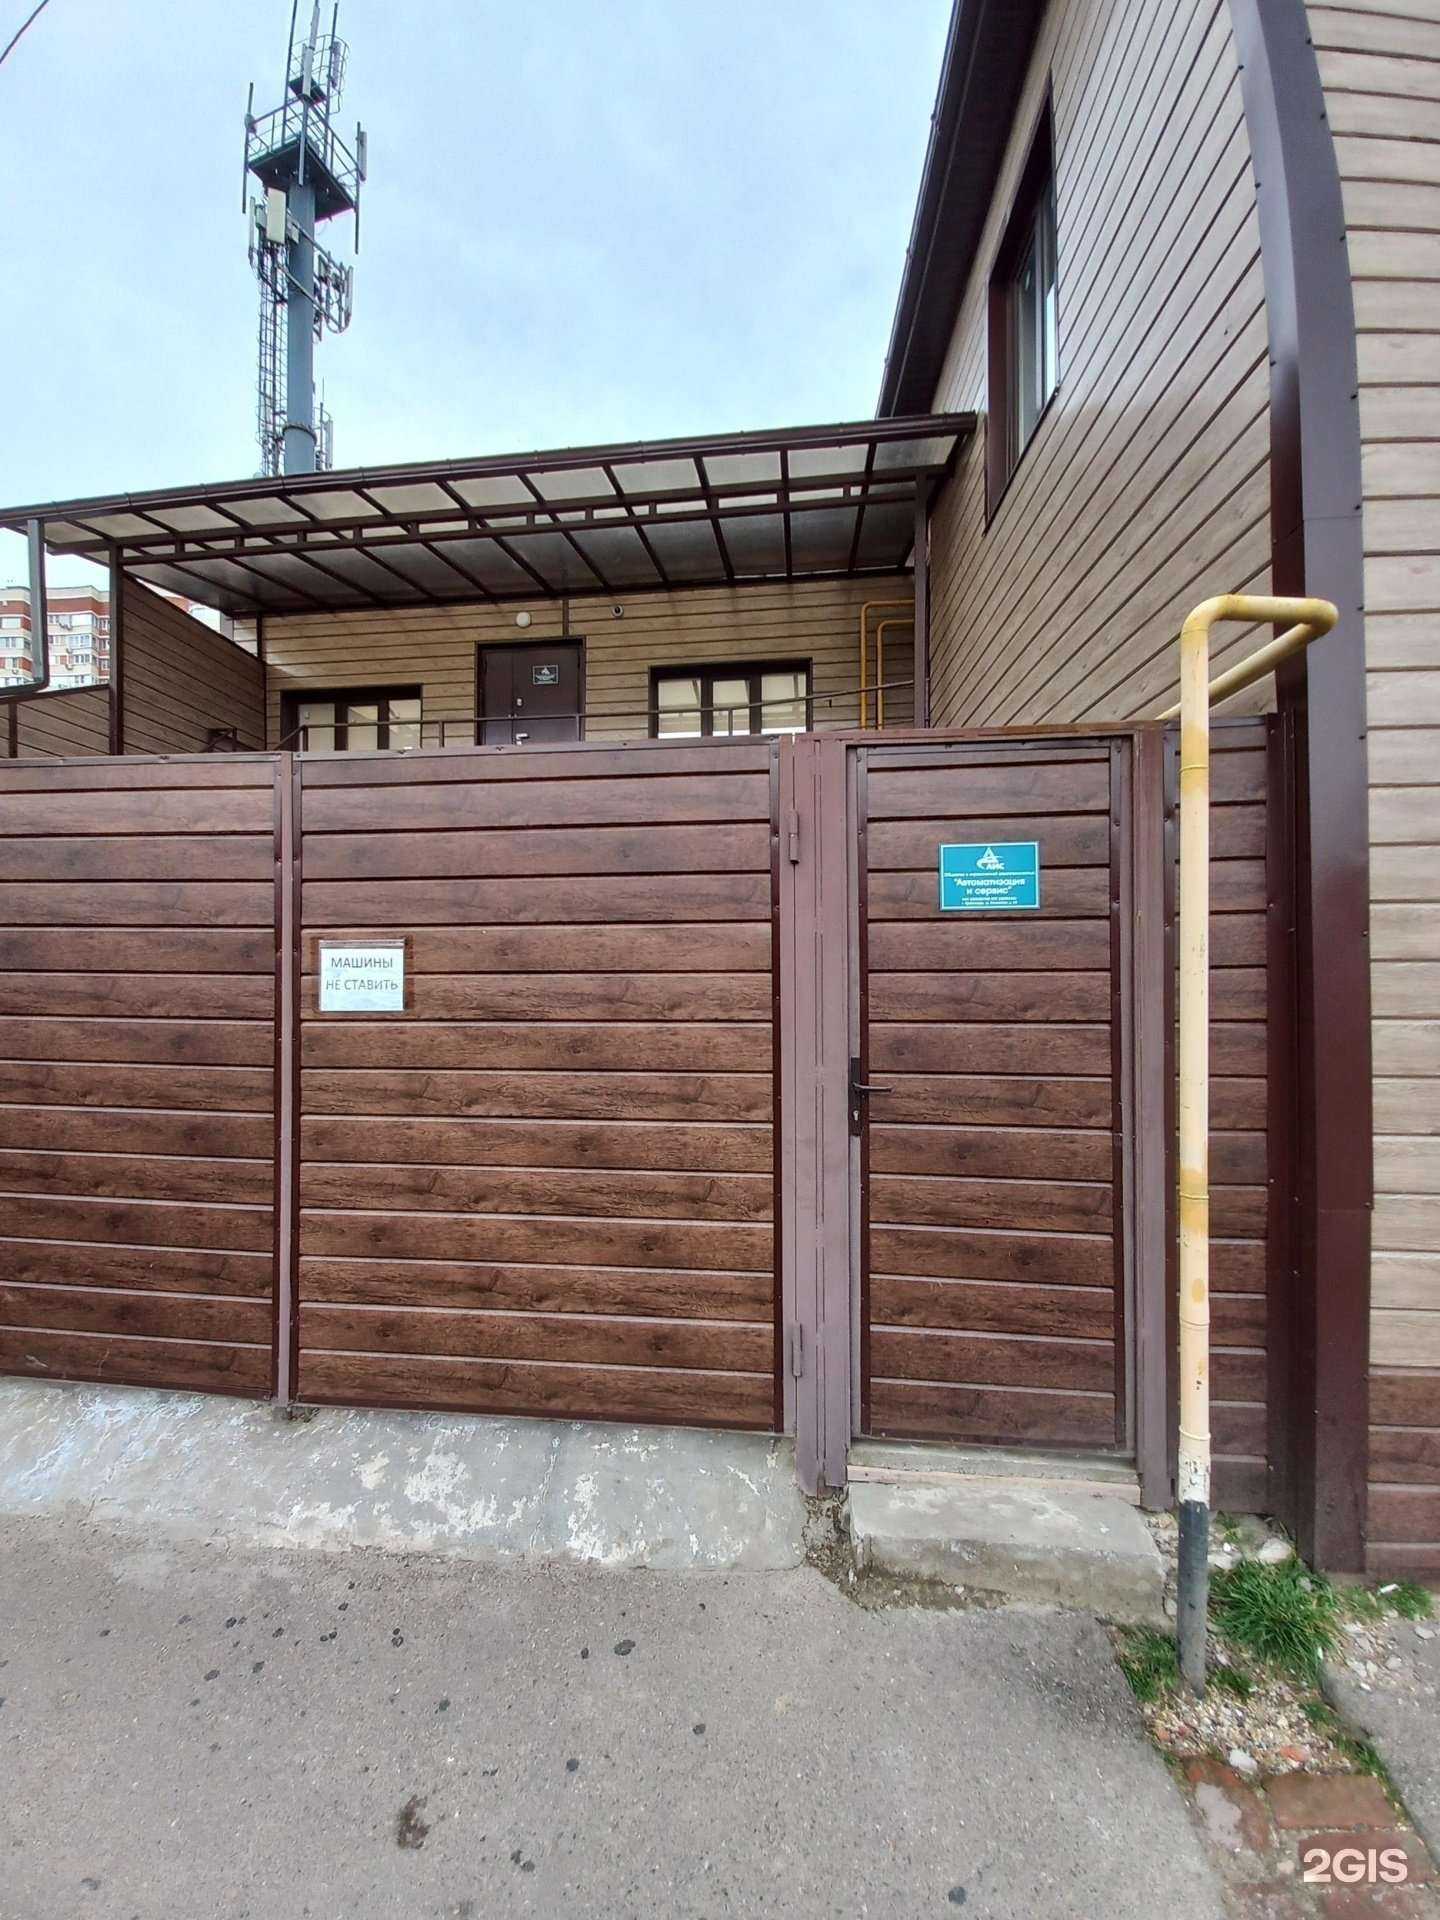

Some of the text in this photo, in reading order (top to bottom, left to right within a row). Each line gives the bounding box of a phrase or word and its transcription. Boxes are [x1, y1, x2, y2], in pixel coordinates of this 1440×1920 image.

[331, 957, 393, 968] МАШИНЫ
[326, 979, 399, 990] НЕ СТАВИТЬ
